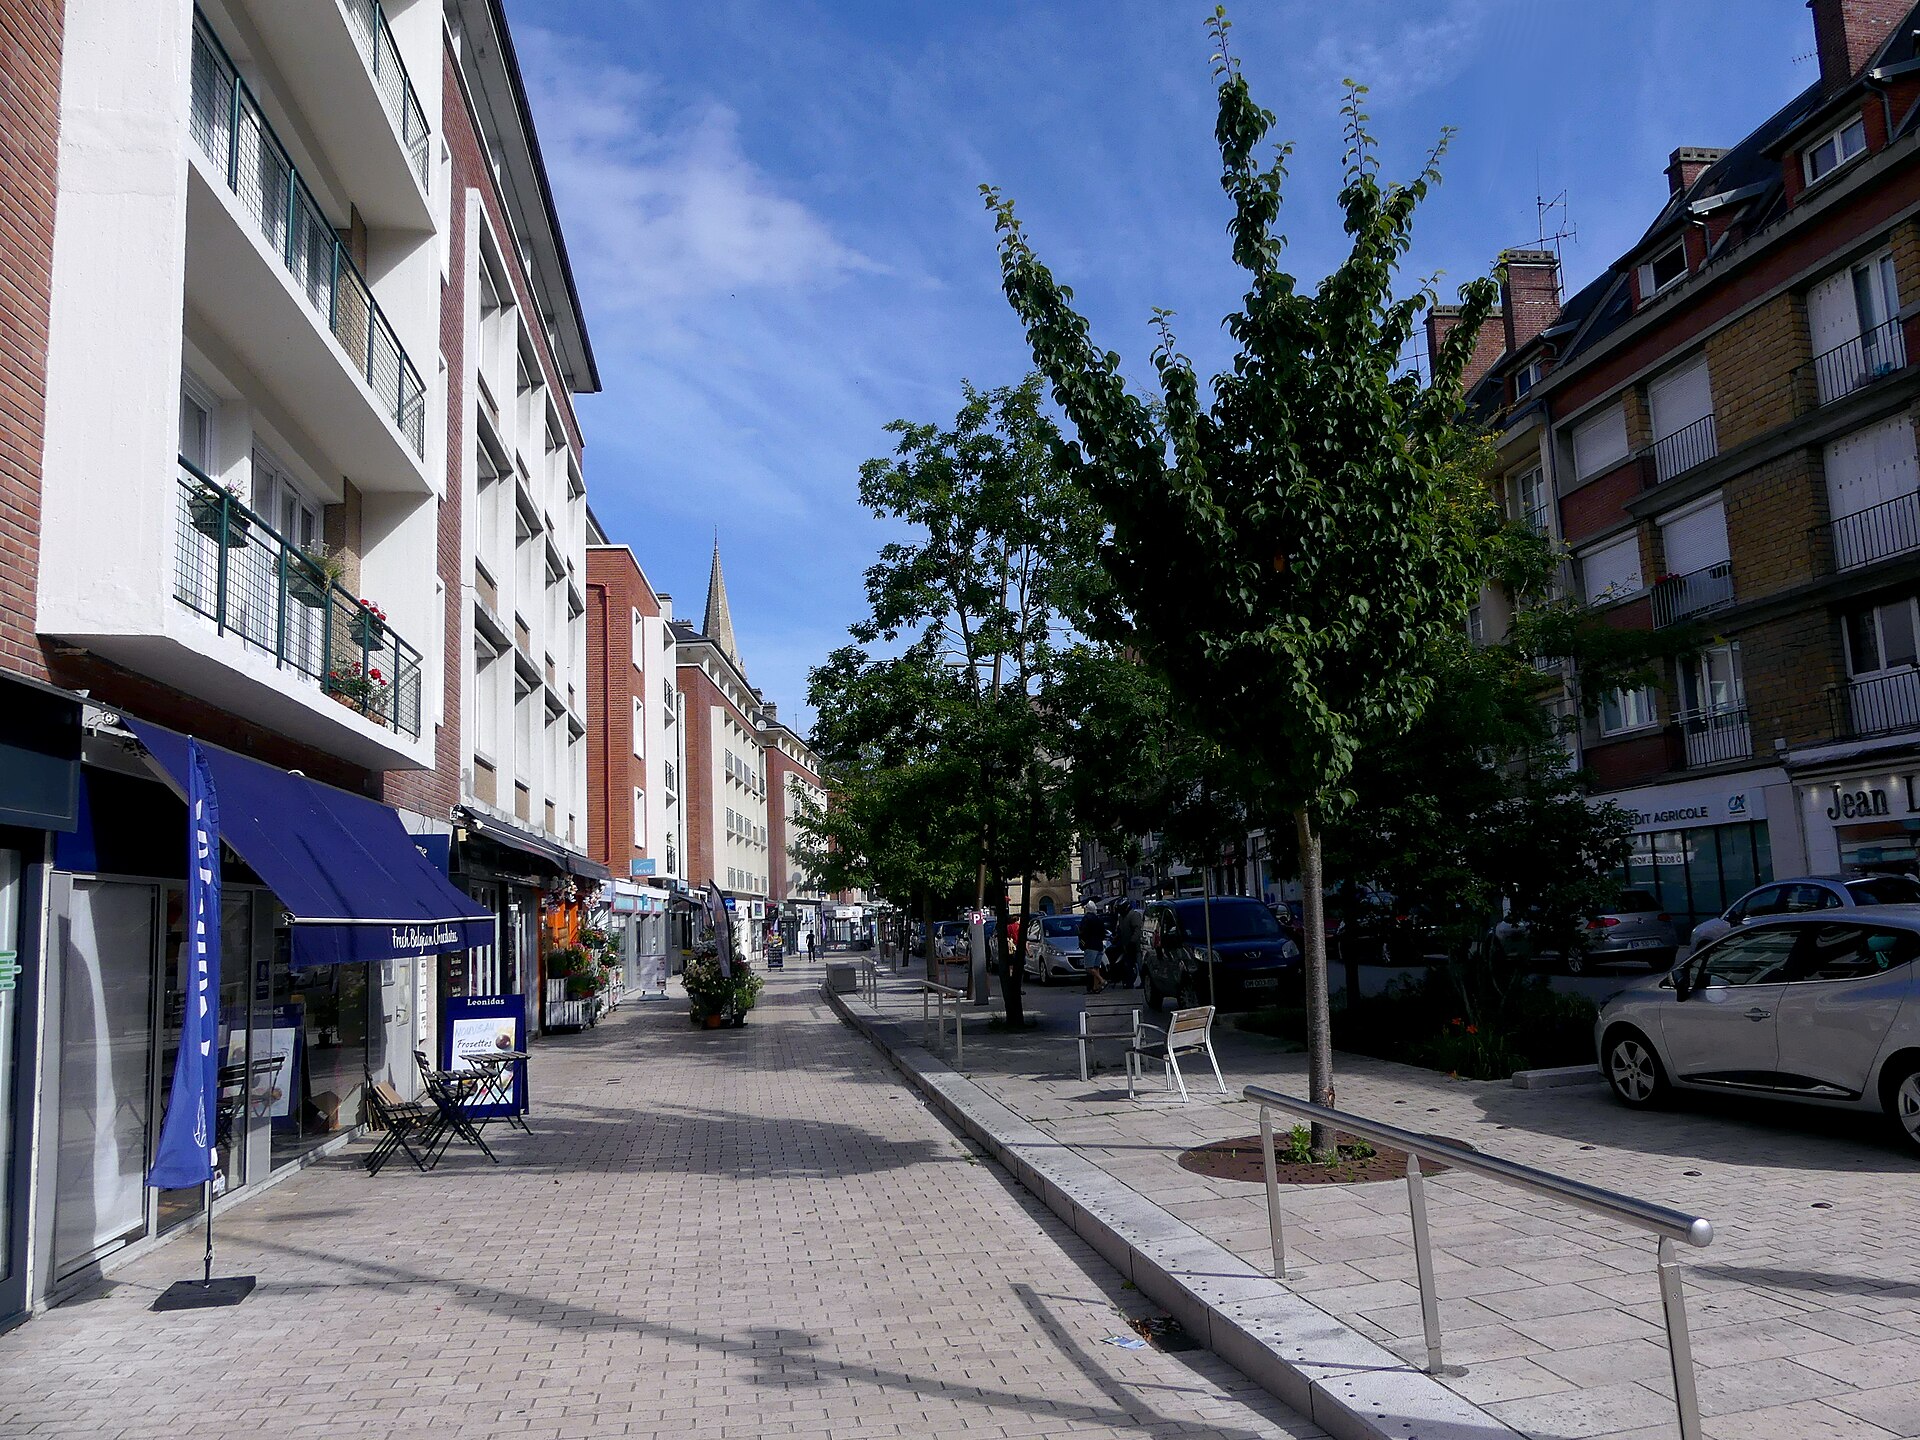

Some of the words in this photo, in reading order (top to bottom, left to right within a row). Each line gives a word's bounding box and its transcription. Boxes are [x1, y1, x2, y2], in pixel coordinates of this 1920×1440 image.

[1827, 785, 1890, 820] Jean
[1653, 806, 1709, 823] AGRICOLE
[973, 913, 981, 925] P
[392, 925, 410, 949] Fresh
[410, 925, 434, 955] Belgian
[434, 923, 459, 946] Chocolates
[467, 998, 505, 1006] Leonidas
